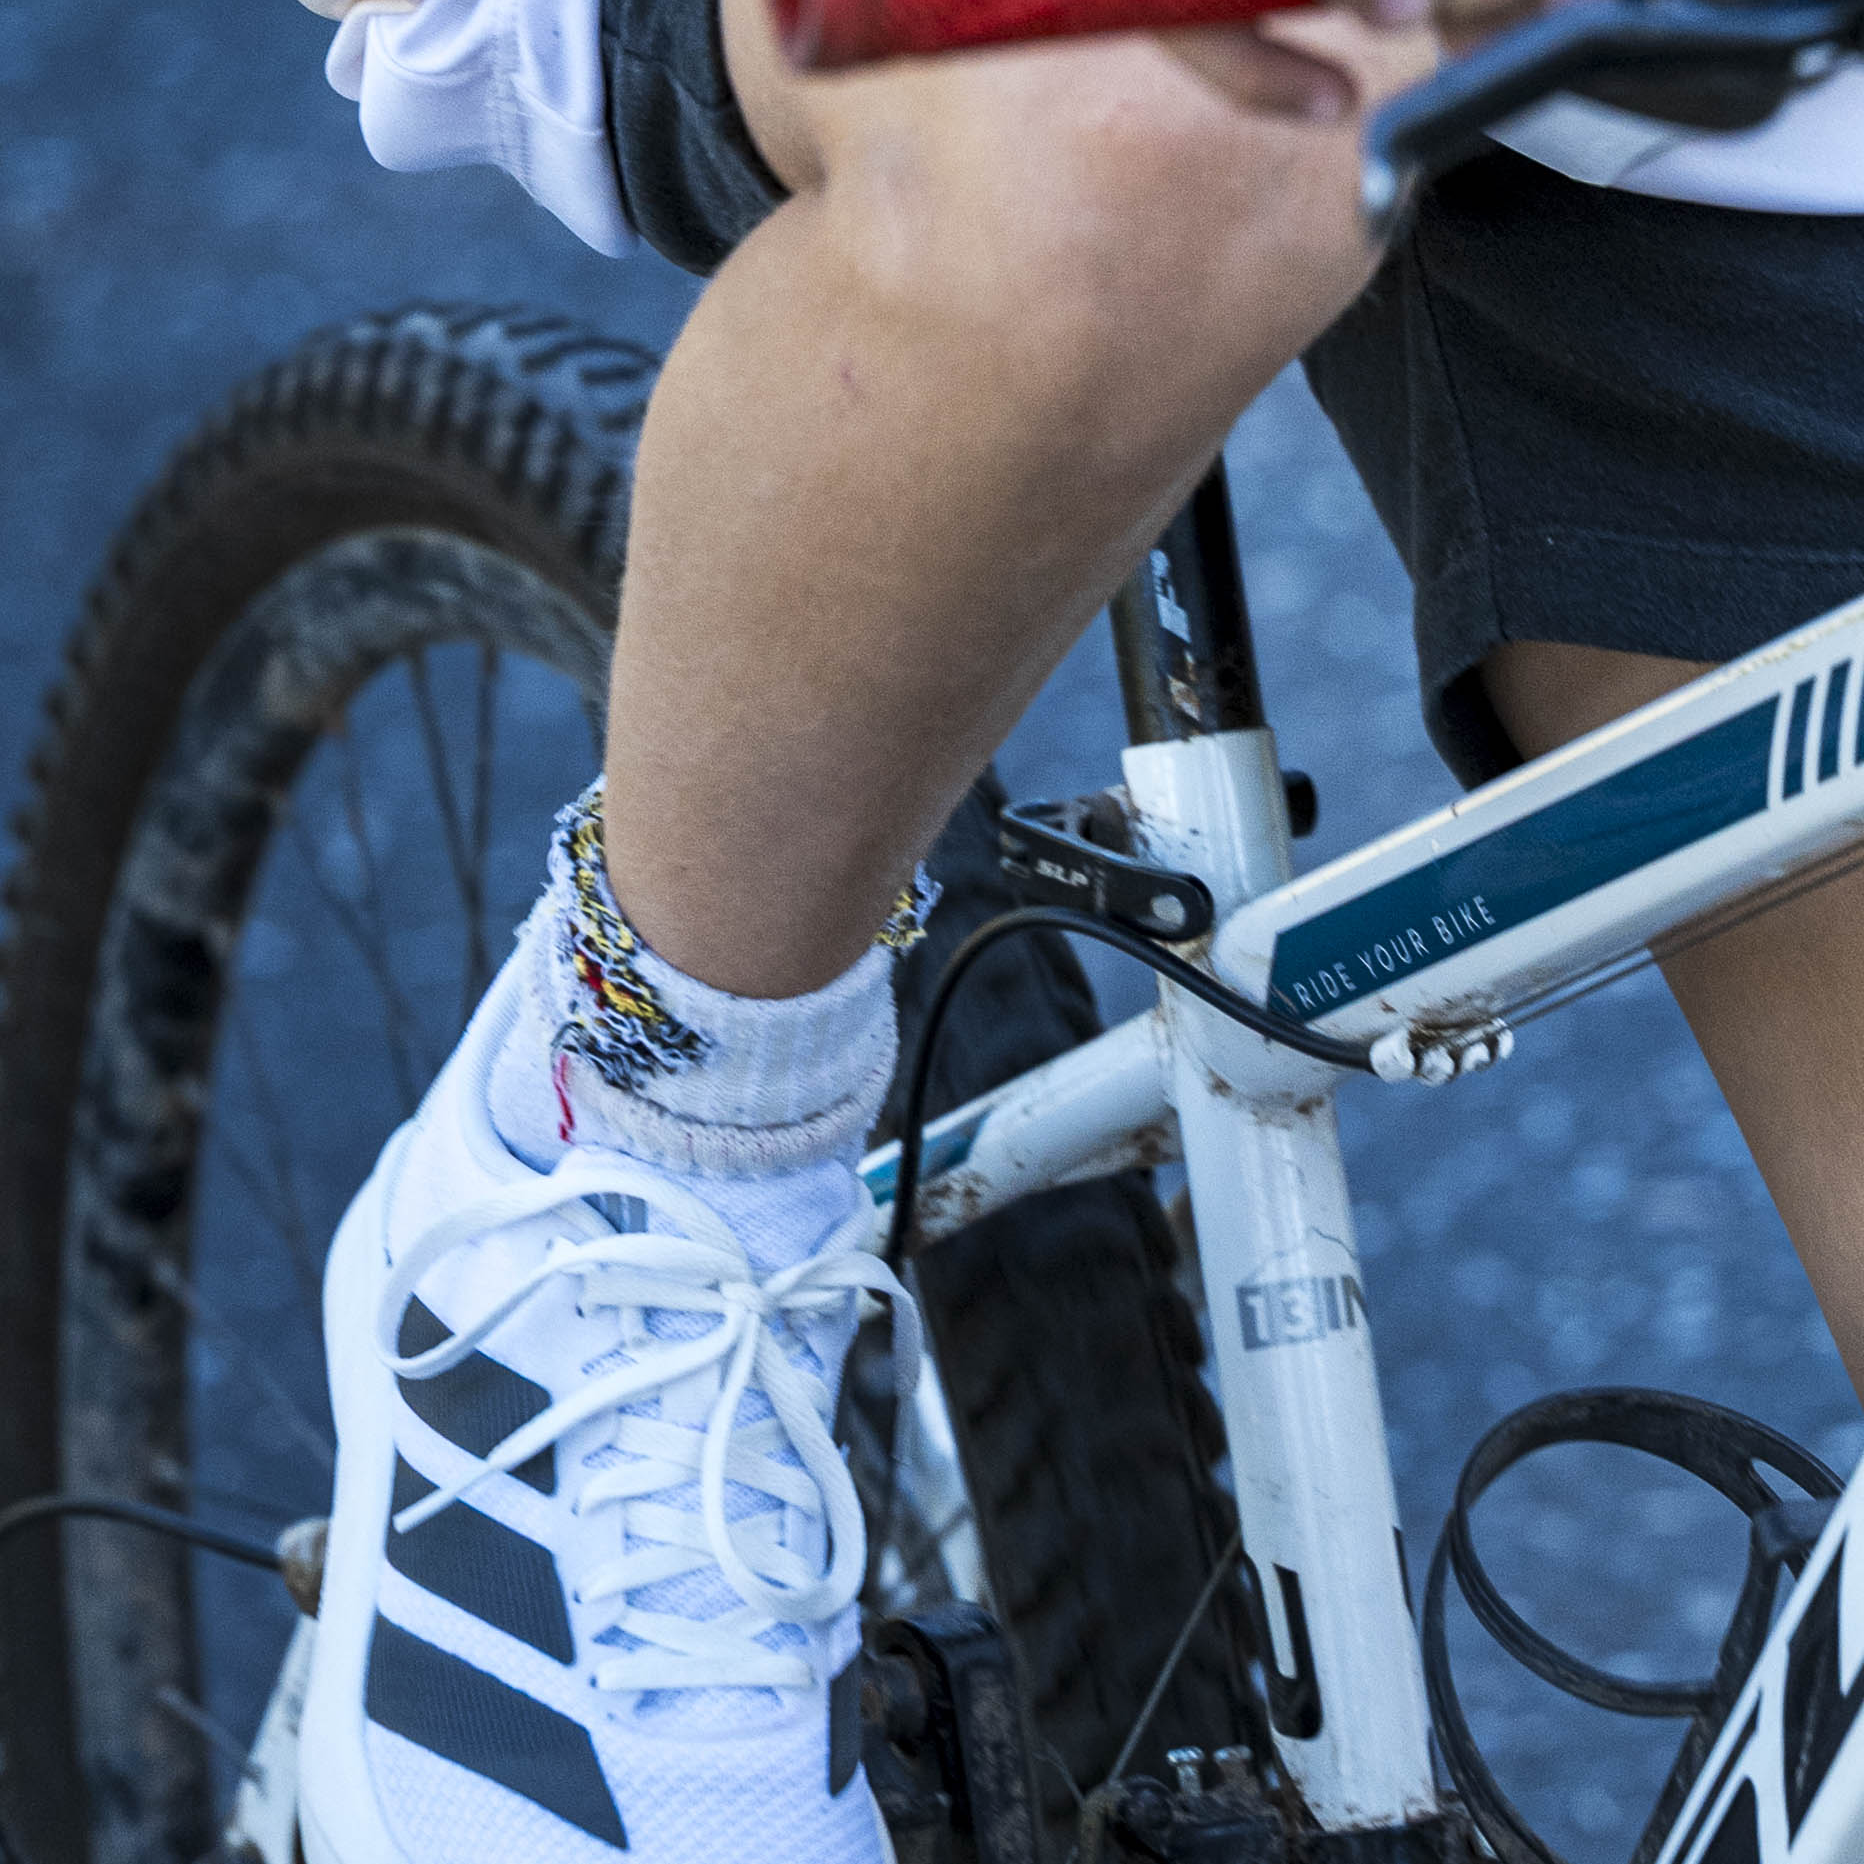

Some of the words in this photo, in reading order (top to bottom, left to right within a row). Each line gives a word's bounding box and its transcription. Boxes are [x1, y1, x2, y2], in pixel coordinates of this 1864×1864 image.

[1292, 961, 1358, 1010] RIDE
[1357, 927, 1431, 980] YOUR
[1431, 894, 1497, 945] BIKE
